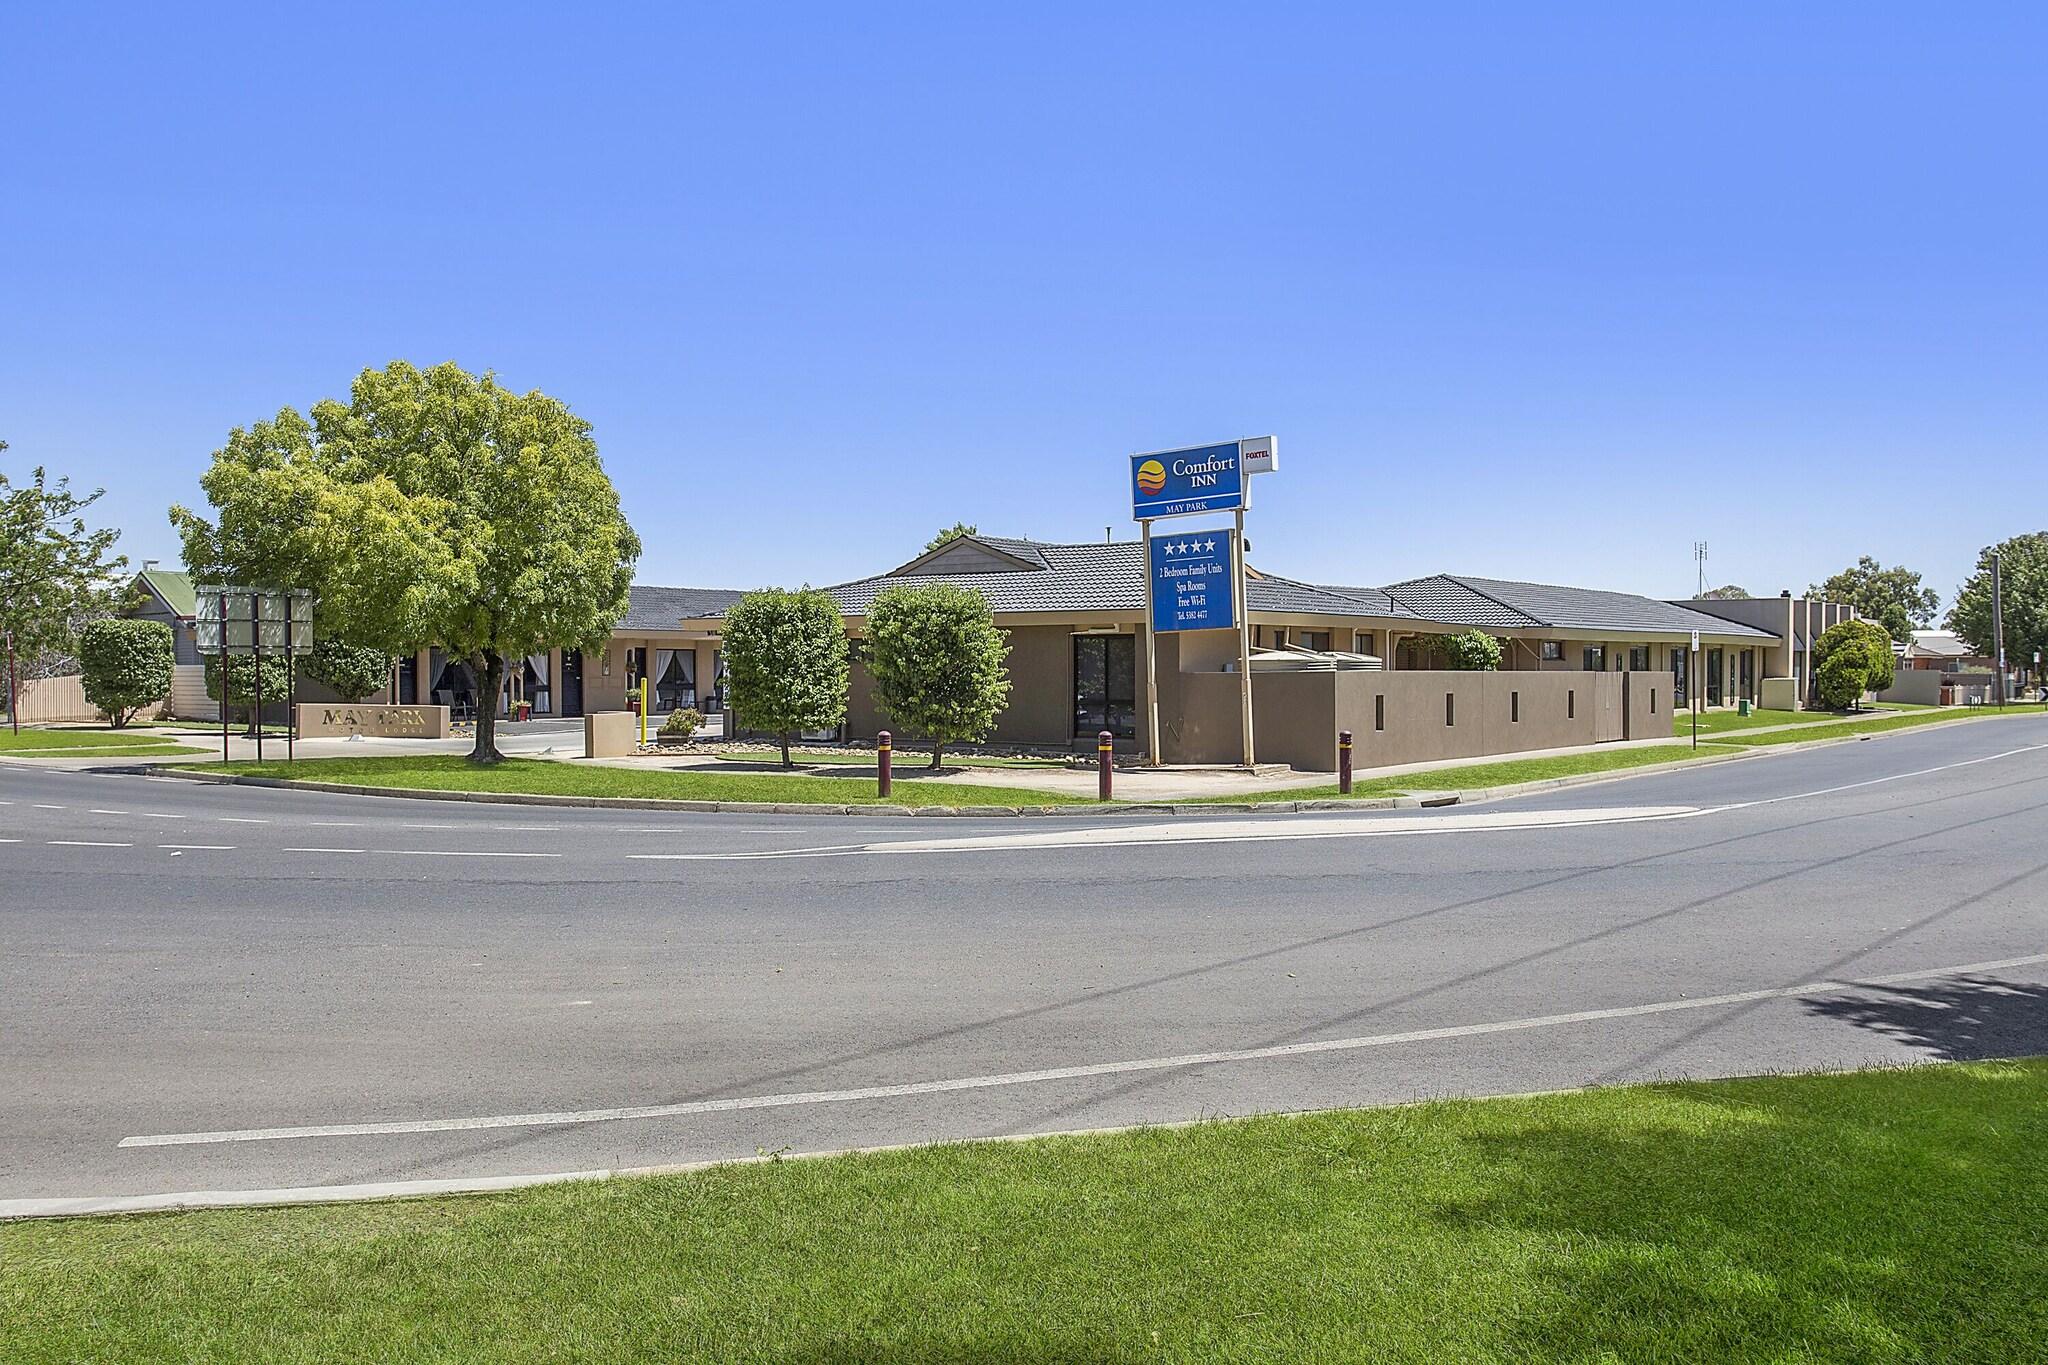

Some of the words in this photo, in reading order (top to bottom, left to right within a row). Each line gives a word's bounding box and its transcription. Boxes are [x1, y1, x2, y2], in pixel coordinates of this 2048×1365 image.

[1246, 451, 1269, 459] FOXTEL
[1173, 455, 1234, 475] Comfort
[1191, 474, 1216, 487] INN
[1165, 504, 1185, 514] MAY
[1186, 501, 1208, 512] PARK
[1164, 566, 1188, 577] Bedroom
[1189, 564, 1207, 576] Family
[1208, 563, 1222, 573] Units
[1176, 581, 1186, 594] Spa
[1187, 580, 1206, 591] Rooms
[1178, 596, 1190, 607] Free
[1190, 595, 1206, 606] Wi-Fi
[322, 709, 373, 726] MAY
